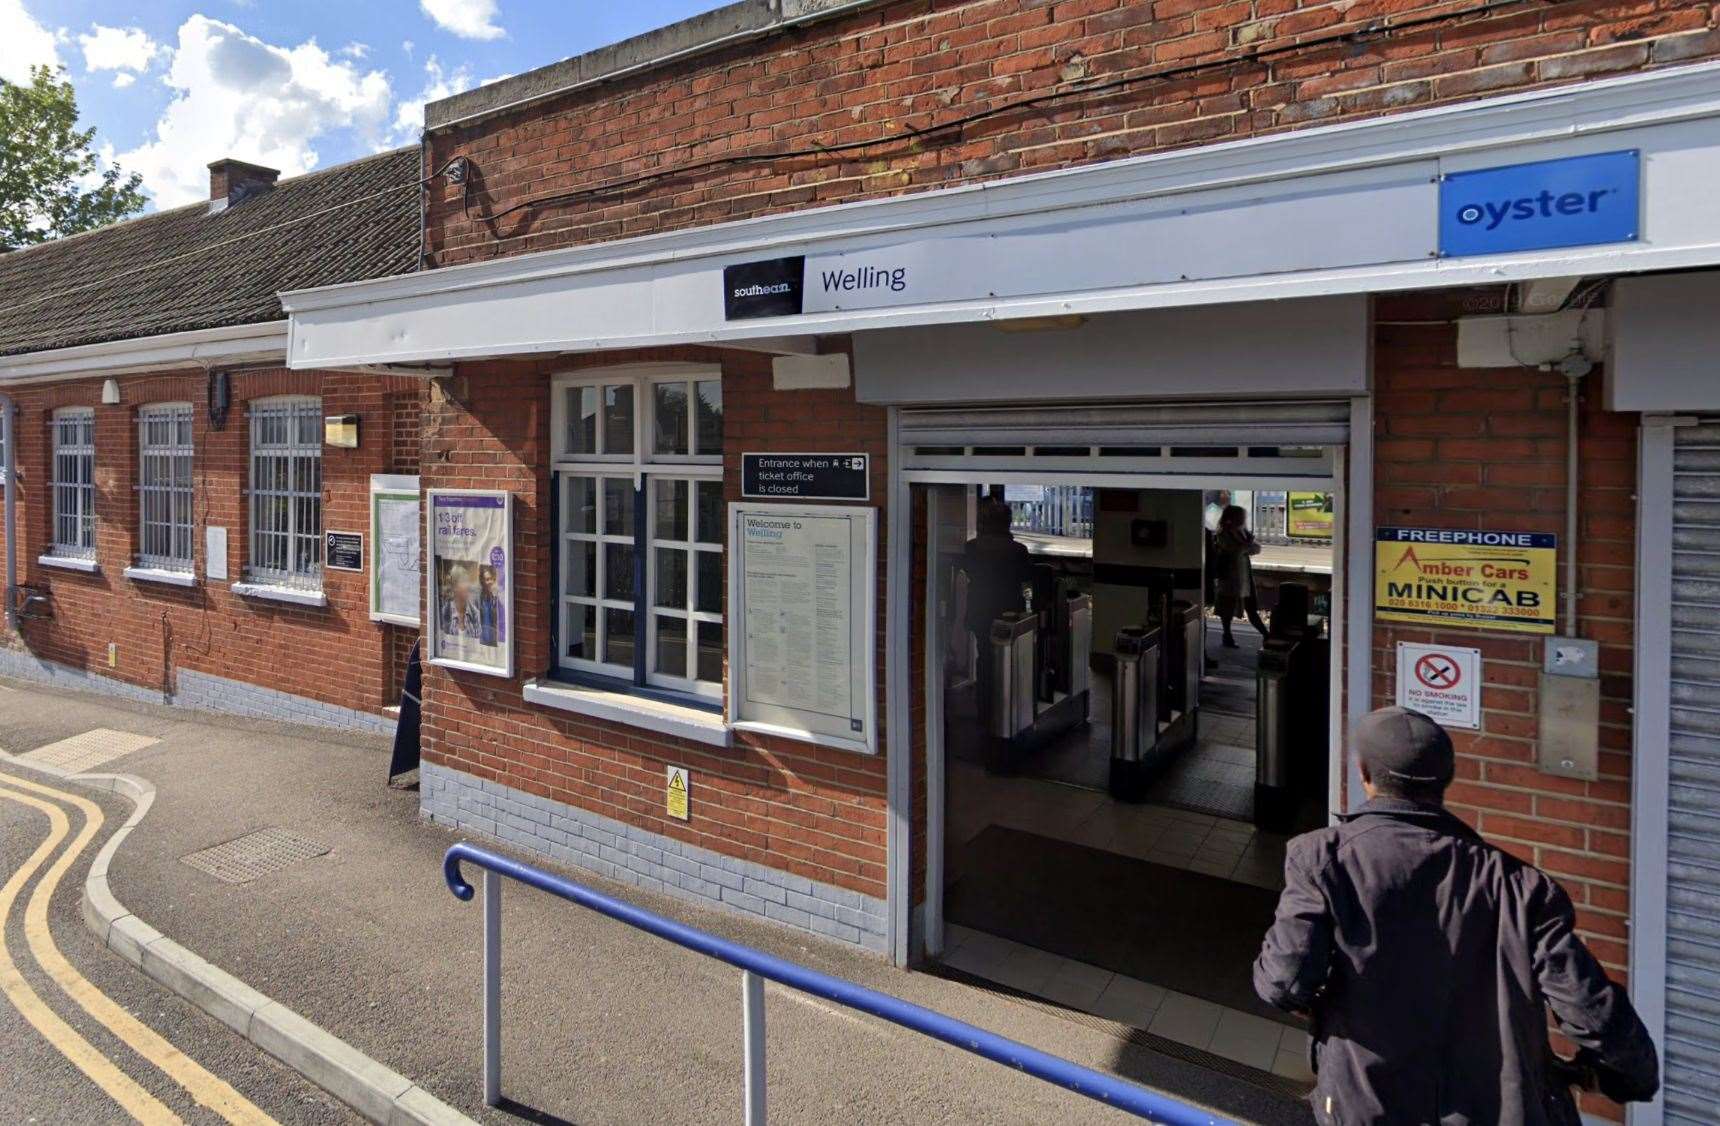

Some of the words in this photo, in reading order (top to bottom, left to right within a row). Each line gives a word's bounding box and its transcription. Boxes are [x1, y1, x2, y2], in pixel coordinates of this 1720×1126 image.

[1456, 188, 1608, 231] oyster
[822, 266, 906, 292] Welling
[759, 458, 800, 468] Entrance
[802, 459, 829, 468] when
[759, 471, 784, 480] ticket
[786, 471, 815, 481] office
[759, 484, 766, 493] is
[767, 484, 799, 494] closed
[747, 519, 790, 530] Welcome
[793, 521, 801, 530] to
[747, 528, 783, 539] Welling
[1397, 529, 1532, 546] FREEPHONE
[1391, 545, 1474, 577] Amber
[1481, 563, 1529, 581] Cars
[1417, 576, 1443, 585] Push
[1446, 578, 1479, 587] button
[1482, 580, 1497, 588] for
[1388, 581, 1541, 607] MINICAB
[1424, 690, 1467, 701] SMOKING
